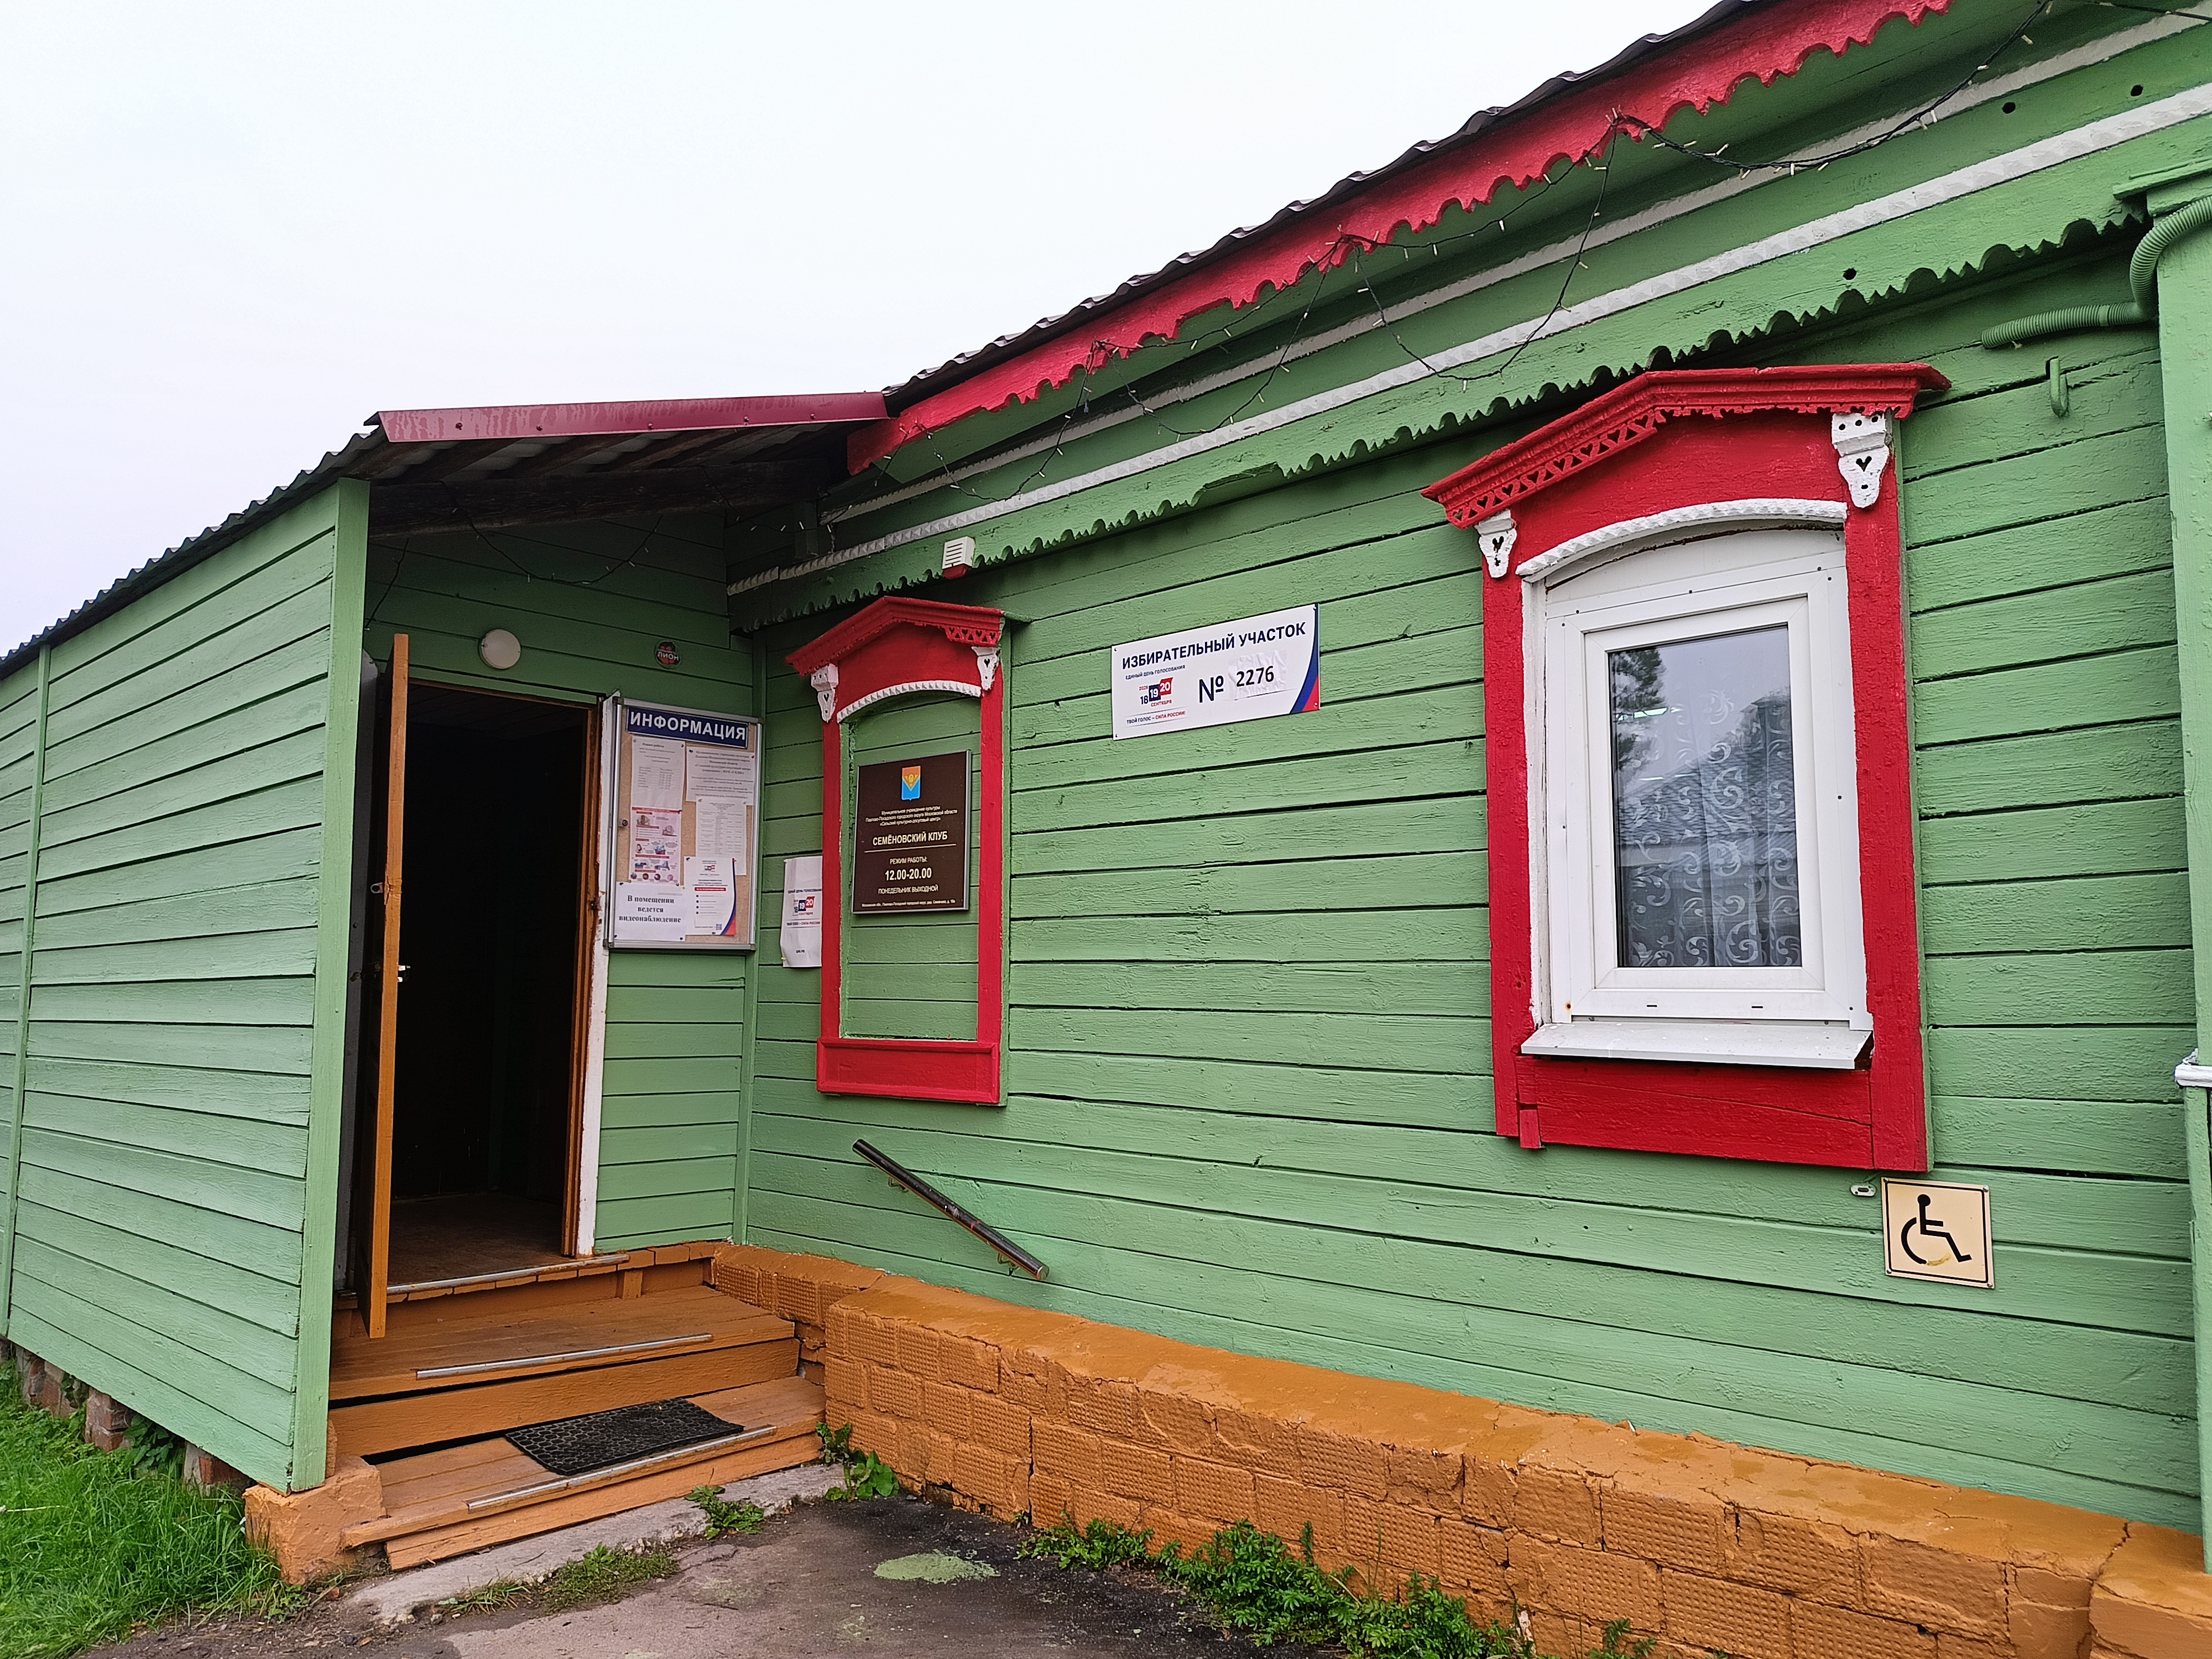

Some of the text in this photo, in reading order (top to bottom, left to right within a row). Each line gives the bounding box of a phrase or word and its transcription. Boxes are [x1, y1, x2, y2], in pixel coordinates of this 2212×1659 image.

[1123, 622, 1306, 669] ИЗБИРАТЕЛЬНЫЙ УЧАСТОК
[658, 651, 679, 661] ЛИОН
[1155, 665, 1185, 674] ГОЛОСОВАНИЯ
[1199, 666, 1274, 703] № 2276
[1140, 682, 1170, 705] 18 19 20
[630, 711, 745, 740] ИНФОРМАЦИЯ
[873, 831, 948, 846] СЕМЁНОВСКИЙ КЛУБ
[885, 868, 932, 880] 12.00-20.00
[912, 884, 938, 893] ВЫХОДНОЙ
